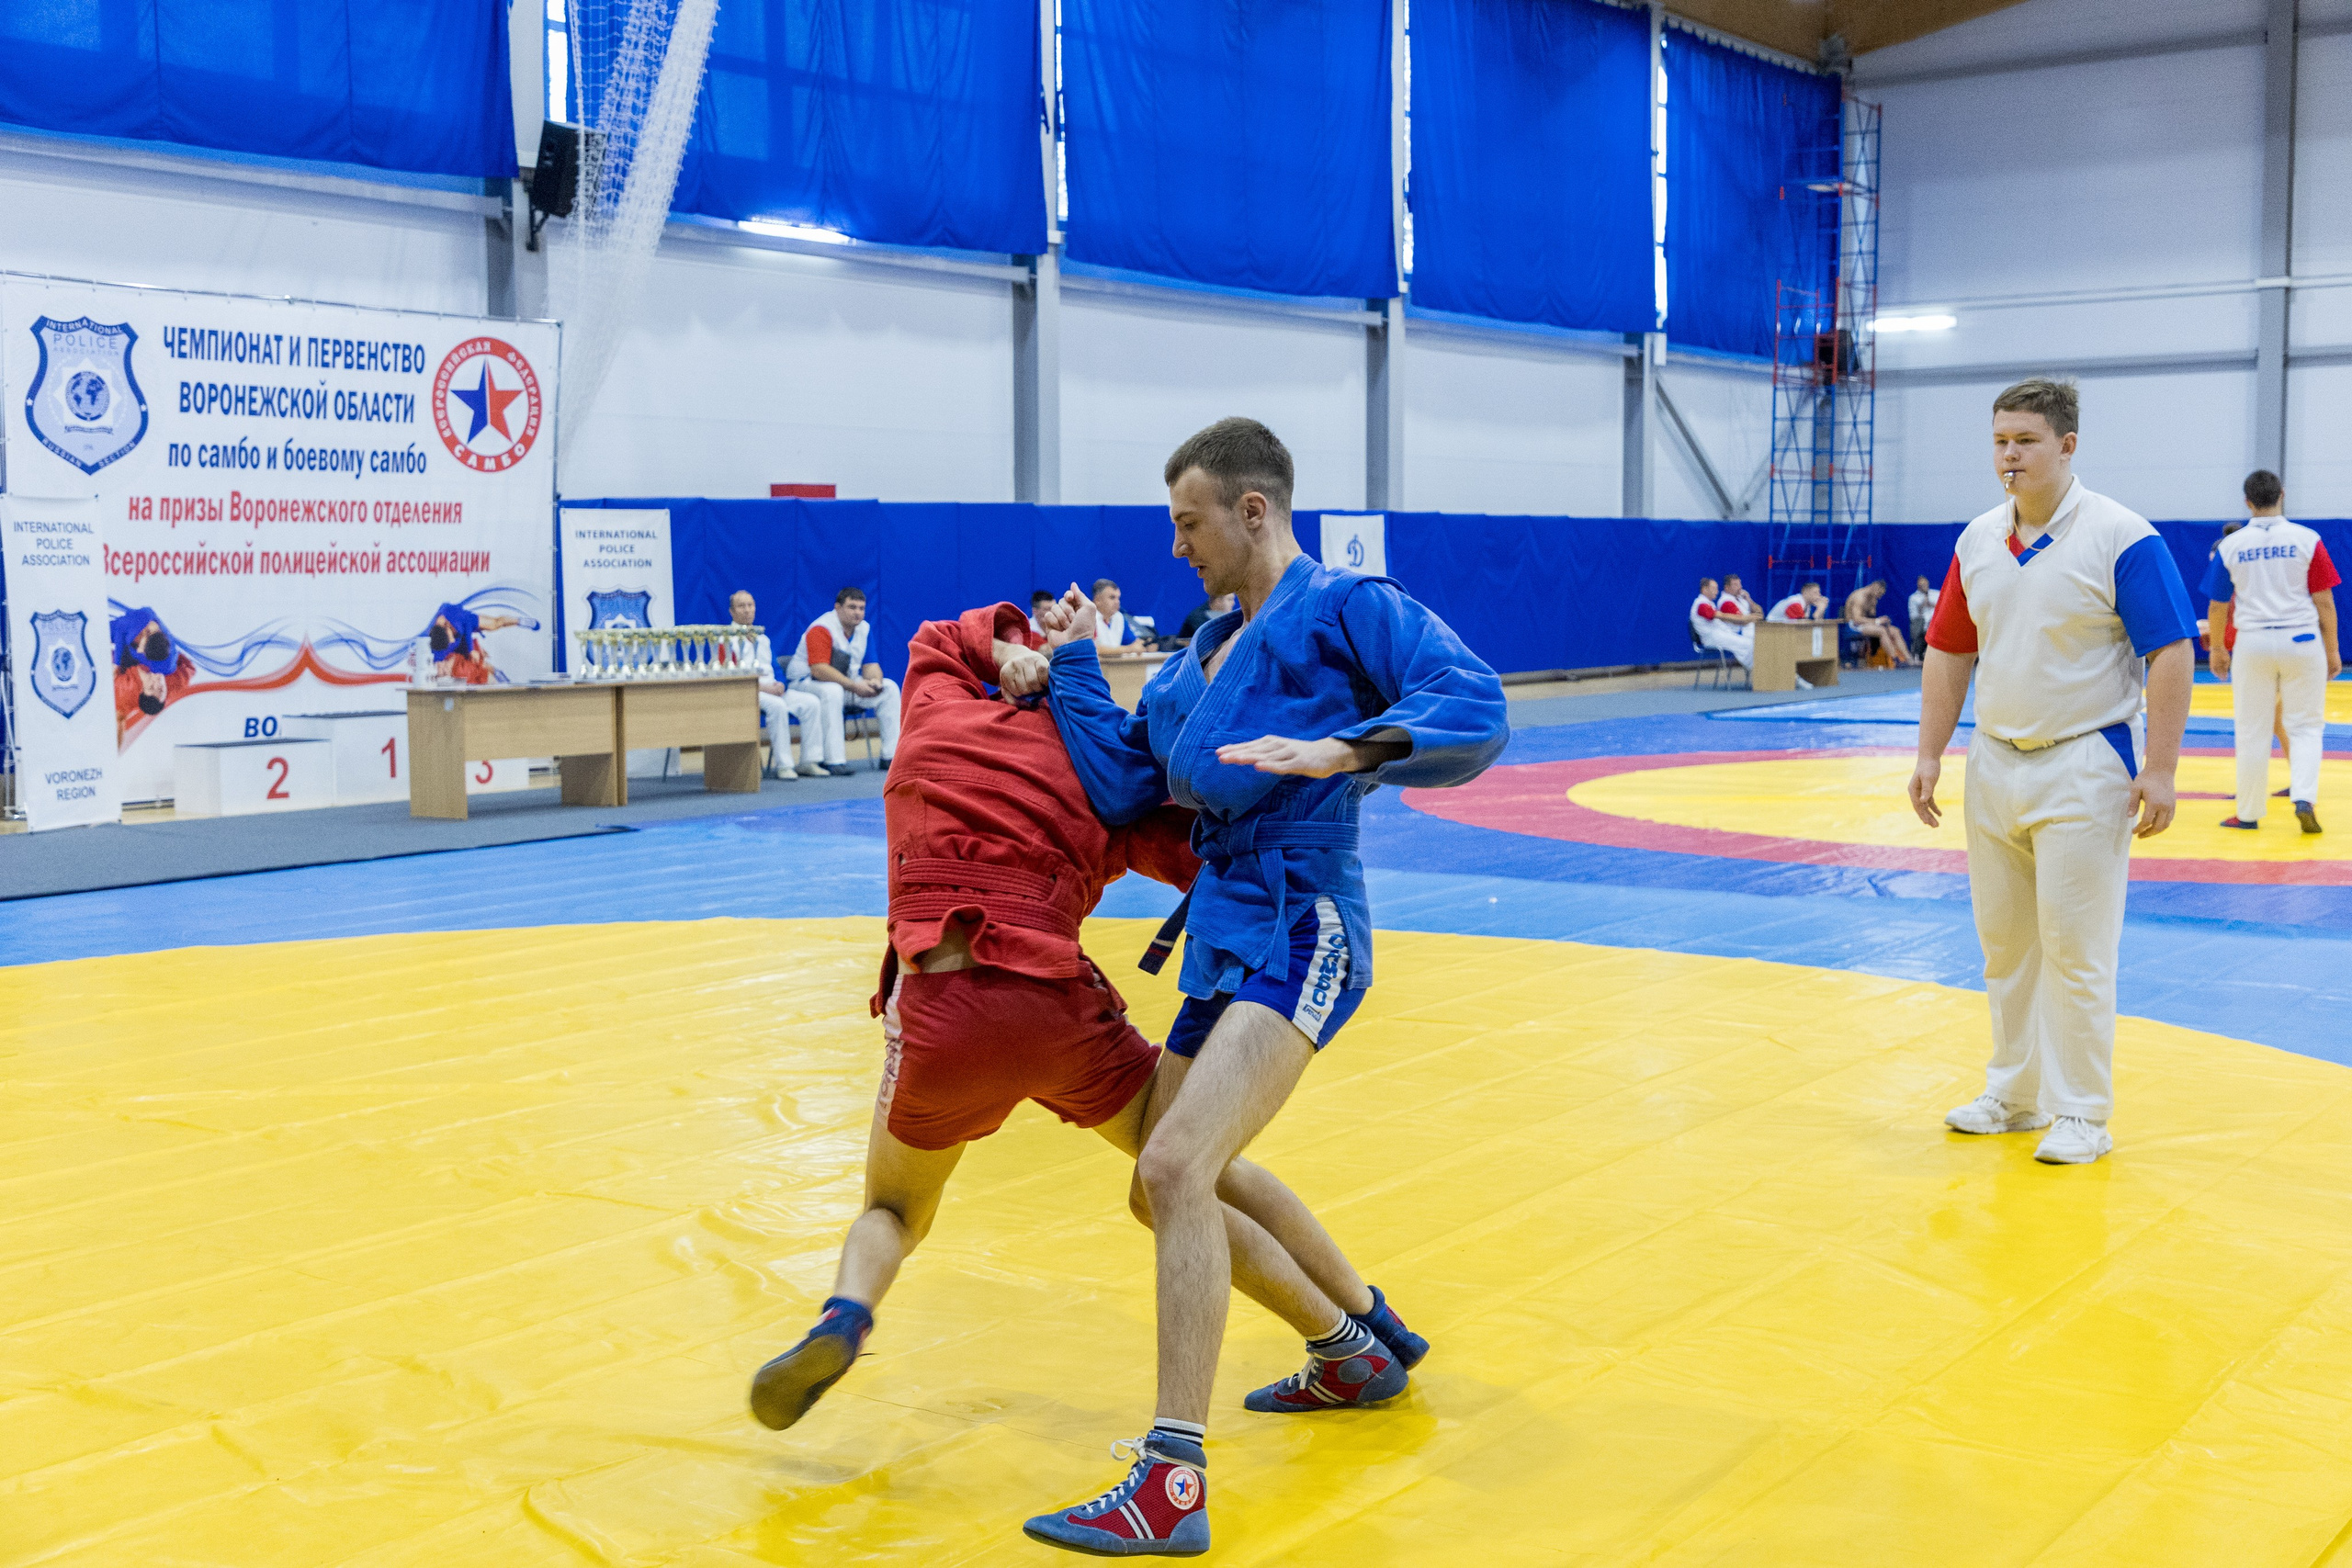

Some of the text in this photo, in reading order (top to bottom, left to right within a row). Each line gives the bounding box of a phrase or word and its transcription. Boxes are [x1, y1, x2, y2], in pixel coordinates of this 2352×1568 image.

[46, 318, 123, 334] INTERNATIONAL
[53, 333, 118, 350] POLICE
[164, 325, 425, 374] ЧЕМПИОНАТ И ПЕРВЕНСТВО
[179, 379, 415, 423] ВОРОНЕЖСКОЙ ОБЛАСТИ
[168, 436, 426, 479] по самбо и боевому самбо
[453, 442, 526, 471] САМБО
[129, 490, 463, 529] на призы Воронежского отделения
[14, 521, 95, 534] INTERNATIONAL
[575, 529, 658, 539] INTERNATIONAL
[36, 537, 74, 550] POLICE
[599, 544, 636, 554] POLICE
[22, 554, 90, 566] ASSOCIATION
[260, 541, 380, 579] полицейской
[386, 549, 491, 578] ассоциации
[2238, 545, 2297, 563] REFEREE
[583, 558, 652, 568] ASSOCIATION
[381, 737, 396, 779] 1
[45, 767, 103, 784] VORONEZH
[266, 756, 290, 799] 2
[56, 785, 96, 800] REGION
[1312, 934, 1347, 1007] САМБО
